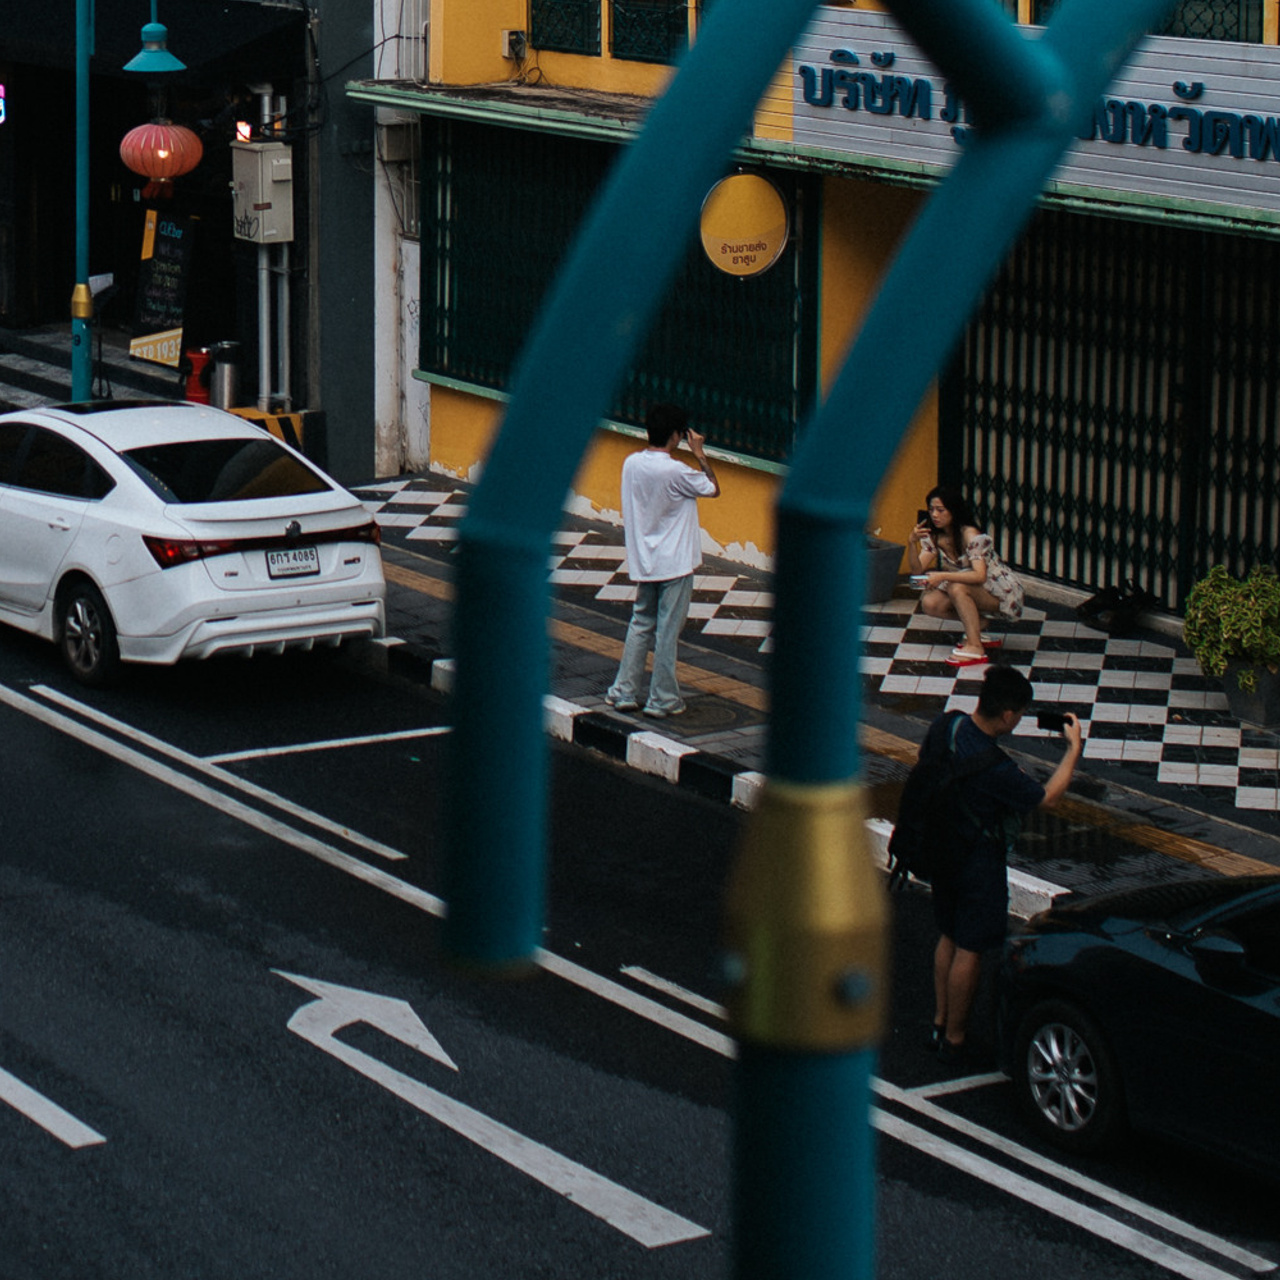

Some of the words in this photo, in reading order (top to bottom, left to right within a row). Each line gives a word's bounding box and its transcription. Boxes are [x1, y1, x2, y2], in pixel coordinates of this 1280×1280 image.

[799, 49, 932, 120] บริษัท
[721, 240, 768, 255] ร้านขายส่ง
[732, 254, 757, 267] ยาสูบ
